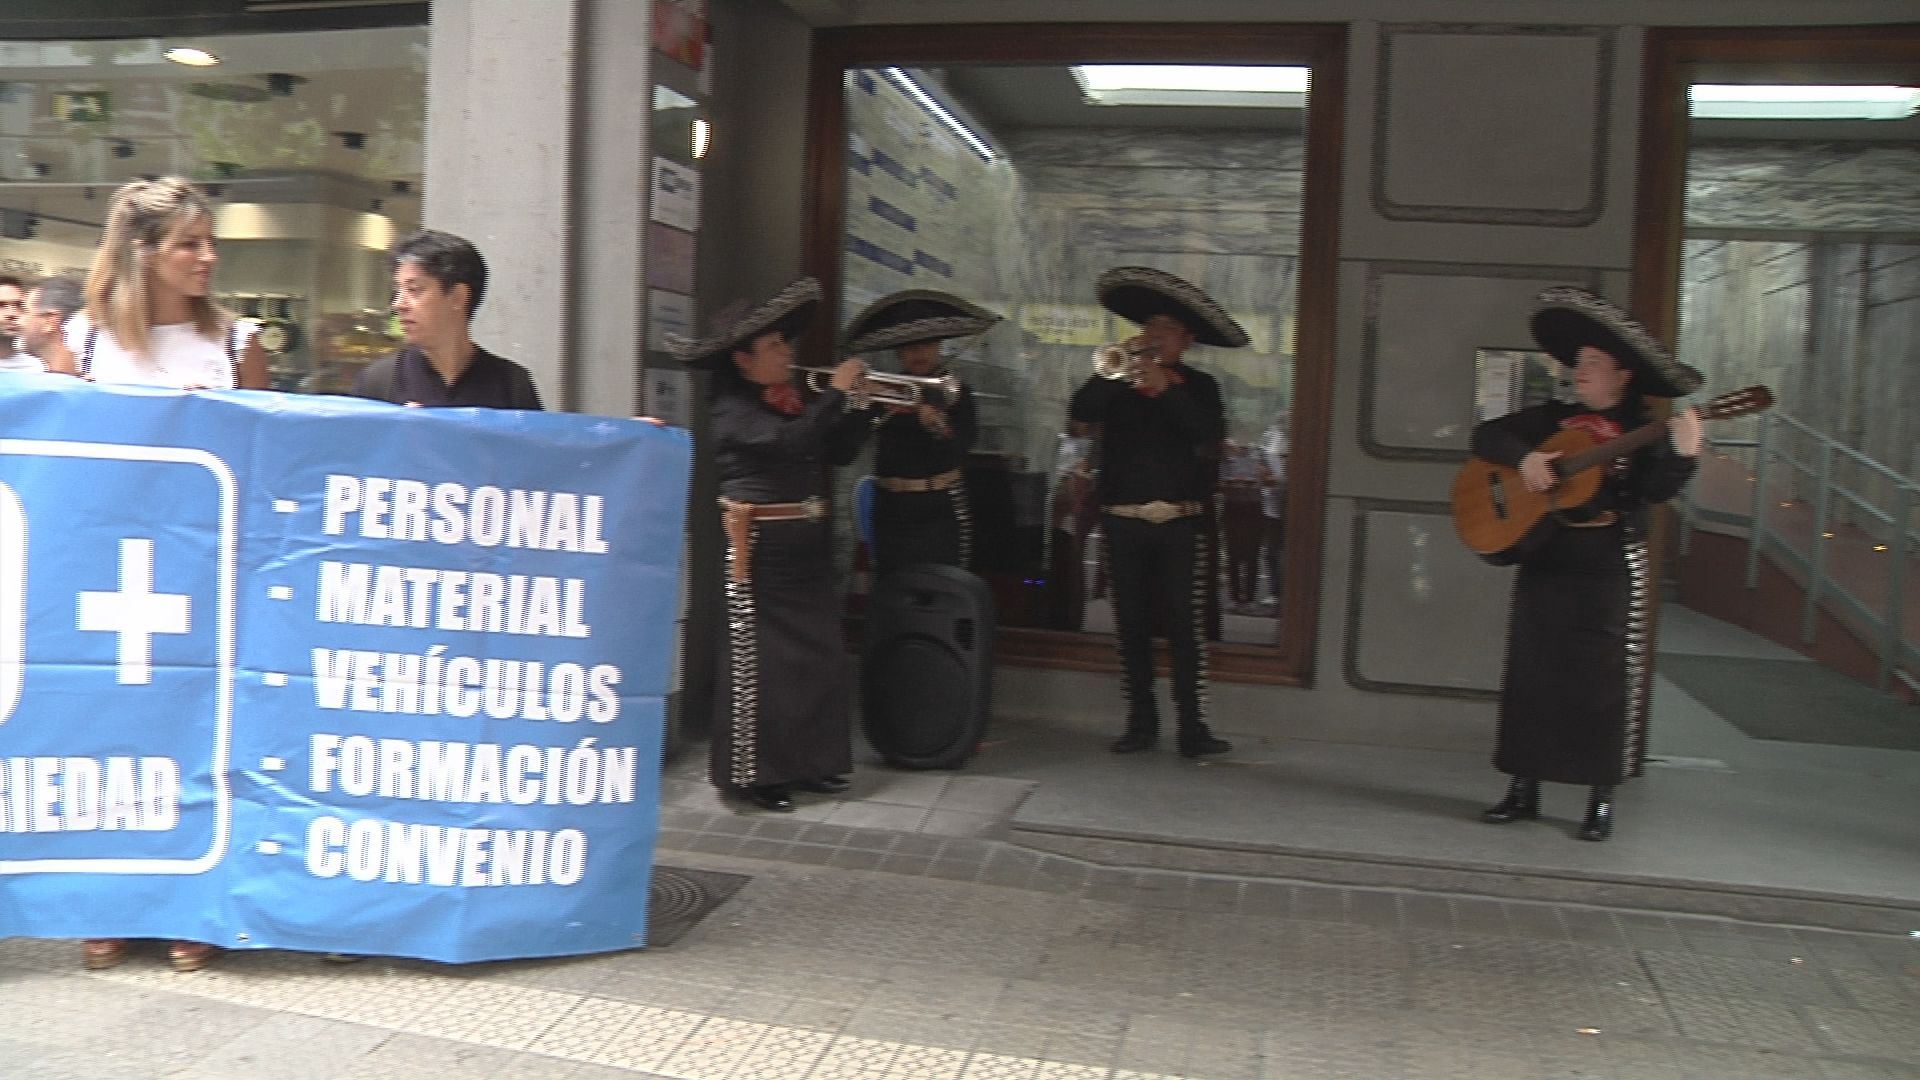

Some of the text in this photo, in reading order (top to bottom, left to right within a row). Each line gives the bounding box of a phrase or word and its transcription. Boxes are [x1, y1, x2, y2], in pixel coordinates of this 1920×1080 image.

[322, 475, 608, 553] PERSONAL
[316, 562, 590, 637] MATERIAL
[312, 645, 621, 722] VEHÍCULOS
[308, 734, 636, 804] FORMACIÓN
[304, 816, 586, 886] CONVENIO
